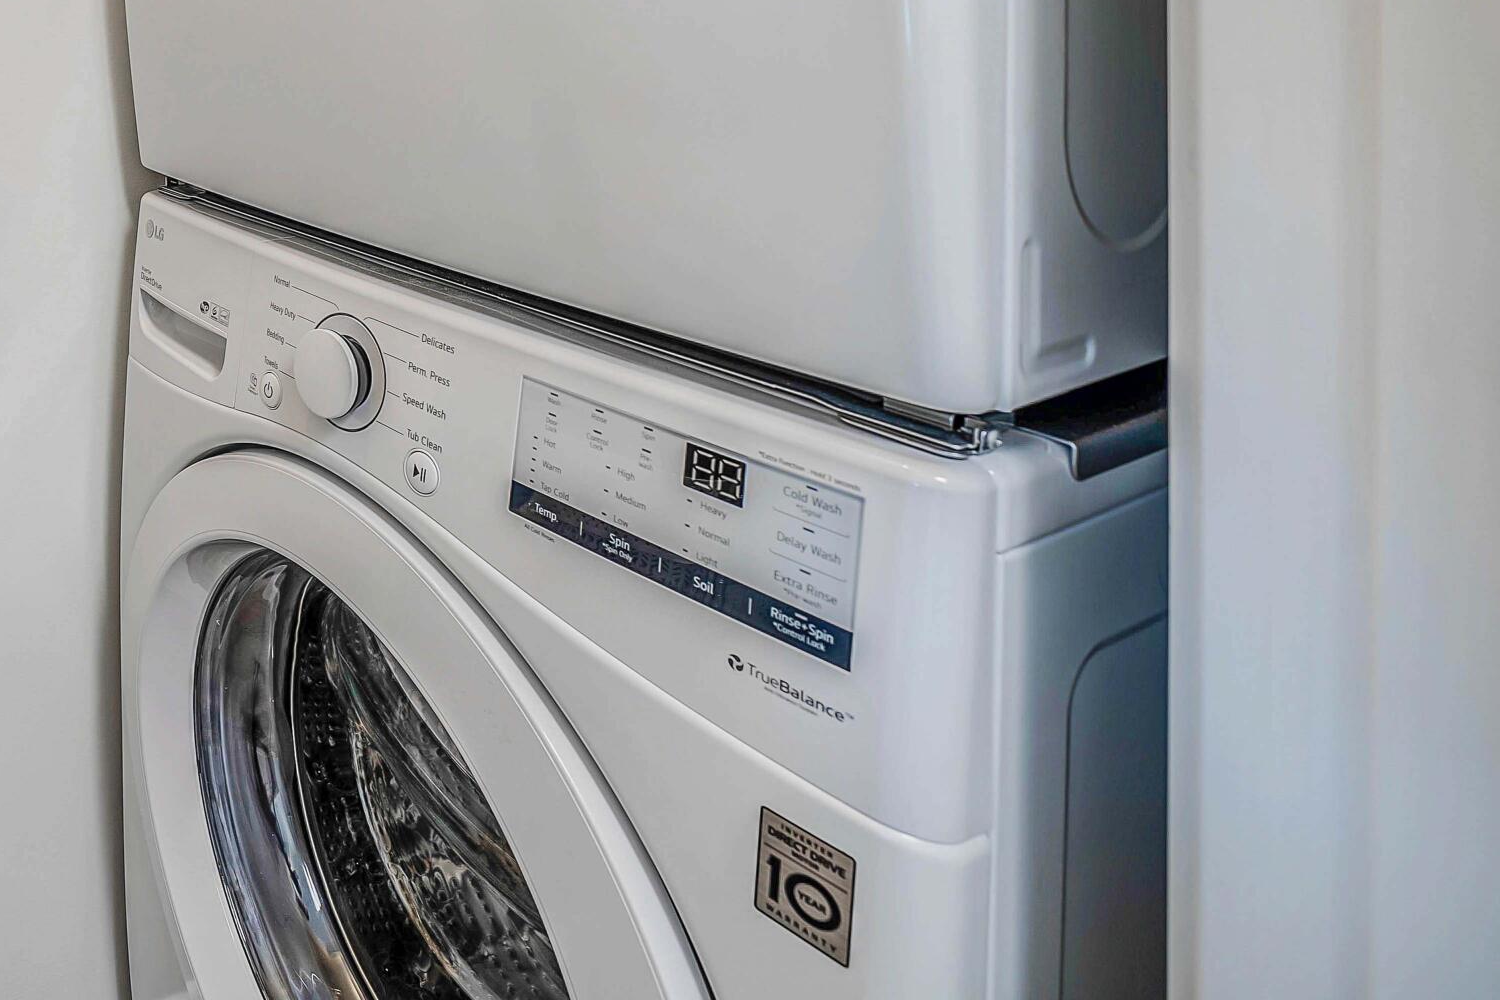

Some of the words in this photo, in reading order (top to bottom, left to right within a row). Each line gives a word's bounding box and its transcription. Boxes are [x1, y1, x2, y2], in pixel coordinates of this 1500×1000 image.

[274, 275, 291, 288] Normal
[270, 301, 284, 316] Heavy
[284, 307, 296, 321] Duty
[266, 328, 285, 345] Bedding
[421, 333, 455, 355] Delicates
[264, 355, 279, 370] Towels
[408, 361, 428, 378] Perm.
[430, 370, 451, 387] Press
[402, 392, 425, 410] Speed
[426, 402, 446, 421] Wash
[407, 428, 420, 442] Tub
[421, 436, 443, 454] Clean
[543, 436, 556, 450] Hot
[542, 459, 562, 475] Warm
[617, 467, 636, 483] High
[540, 481, 553, 495] Tap
[553, 486, 570, 502] Cold
[615, 491, 647, 511] Medium
[782, 485, 809, 504] Cold
[811, 496, 843, 517] Wash
[534, 502, 559, 523] Temp.
[700, 500, 728, 521] Heavy
[613, 514, 629, 529] Low
[609, 533, 631, 552] Spin
[698, 525, 731, 548] Normal
[618, 548, 634, 563] Only
[776, 530, 808, 554] Delay
[810, 543, 842, 566] Wash
[695, 550, 719, 570] Light
[693, 575, 715, 596] Soil
[773, 569, 804, 591] Extra
[805, 582, 839, 606] Rinse
[770, 606, 835, 645] Rinse+Spin
[805, 636, 827, 653] Lock
[780, 822, 834, 859] INVERTER
[767, 825, 808, 855] DIRECT
[809, 849, 848, 881] DRIVE
[766, 853, 842, 933] 10
[797, 889, 828, 917] YEAR
[765, 902, 838, 953] WARRANTY
